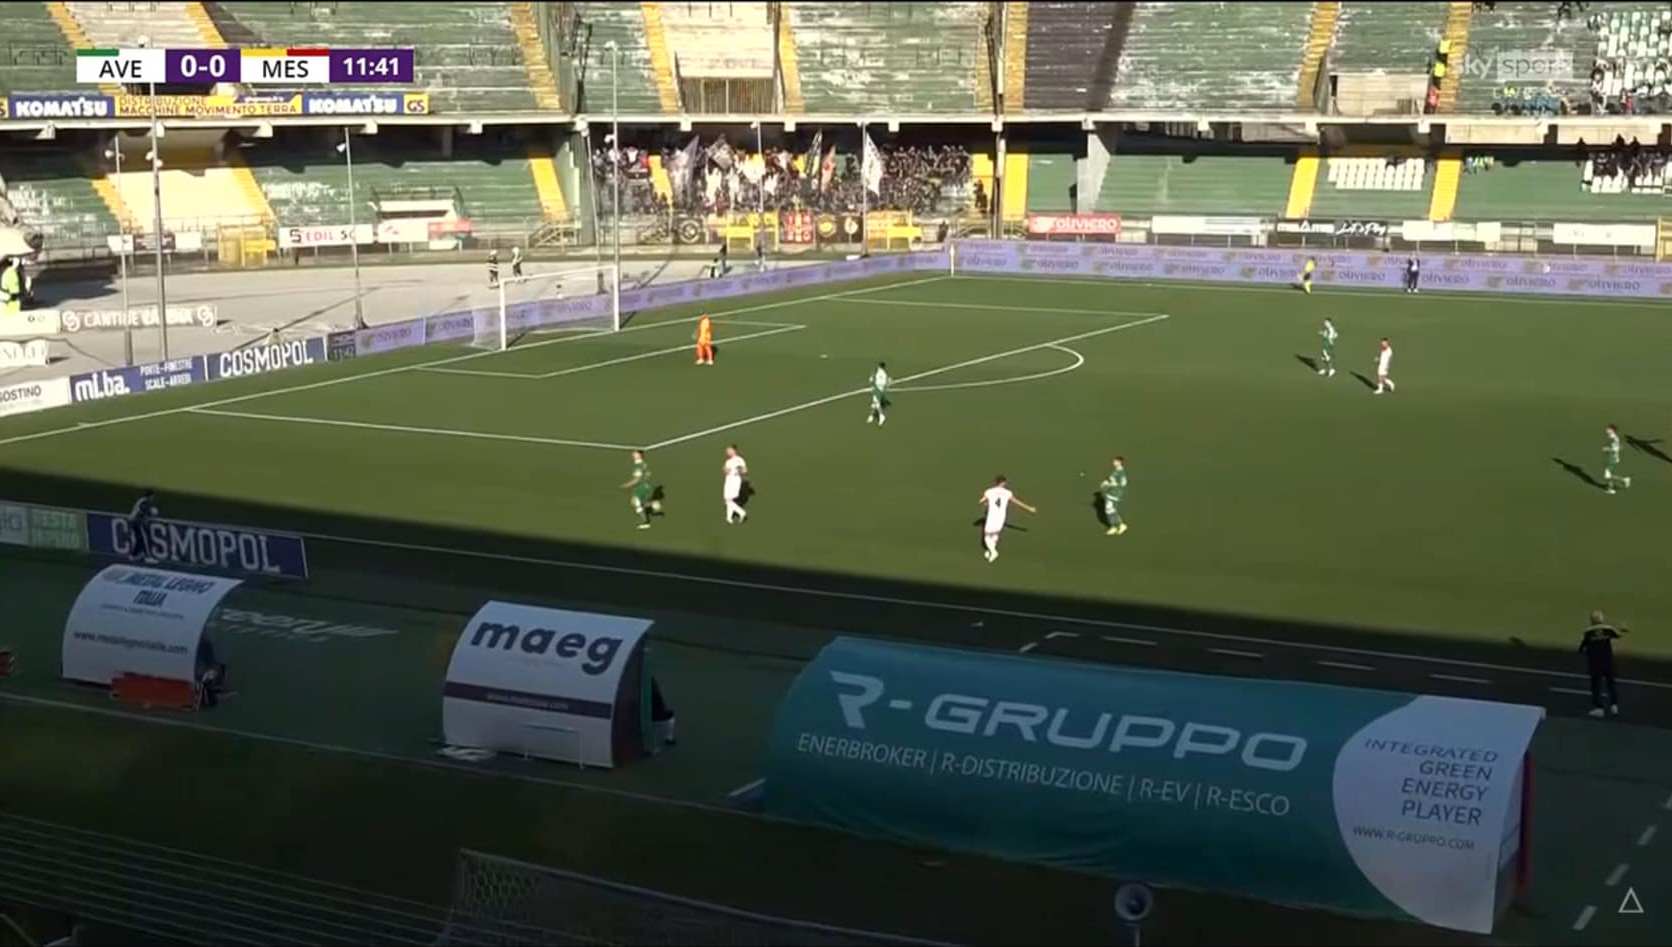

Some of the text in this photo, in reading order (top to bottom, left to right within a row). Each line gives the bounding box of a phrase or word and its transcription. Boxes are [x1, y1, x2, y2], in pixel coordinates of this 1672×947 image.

[15, 96, 108, 117] KOMATSU
[119, 104, 298, 115] MACCHINE MOVIMENTO TERRA
[308, 95, 398, 114] KOMATSU
[406, 99, 425, 113] GS
[219, 341, 313, 378] COSMOPOL
[112, 518, 280, 573] CSMOPOL
[470, 621, 623, 676] maeg
[1364, 738, 1499, 763] INTEGRATED
[797, 732, 1291, 817] ENERBROKER R-DISTRIBUZIONE R-EV R-ESCO
[1418, 759, 1494, 782] GREEN
[1401, 777, 1490, 802] ENERGY
[1401, 799, 1483, 826] PLAYER
